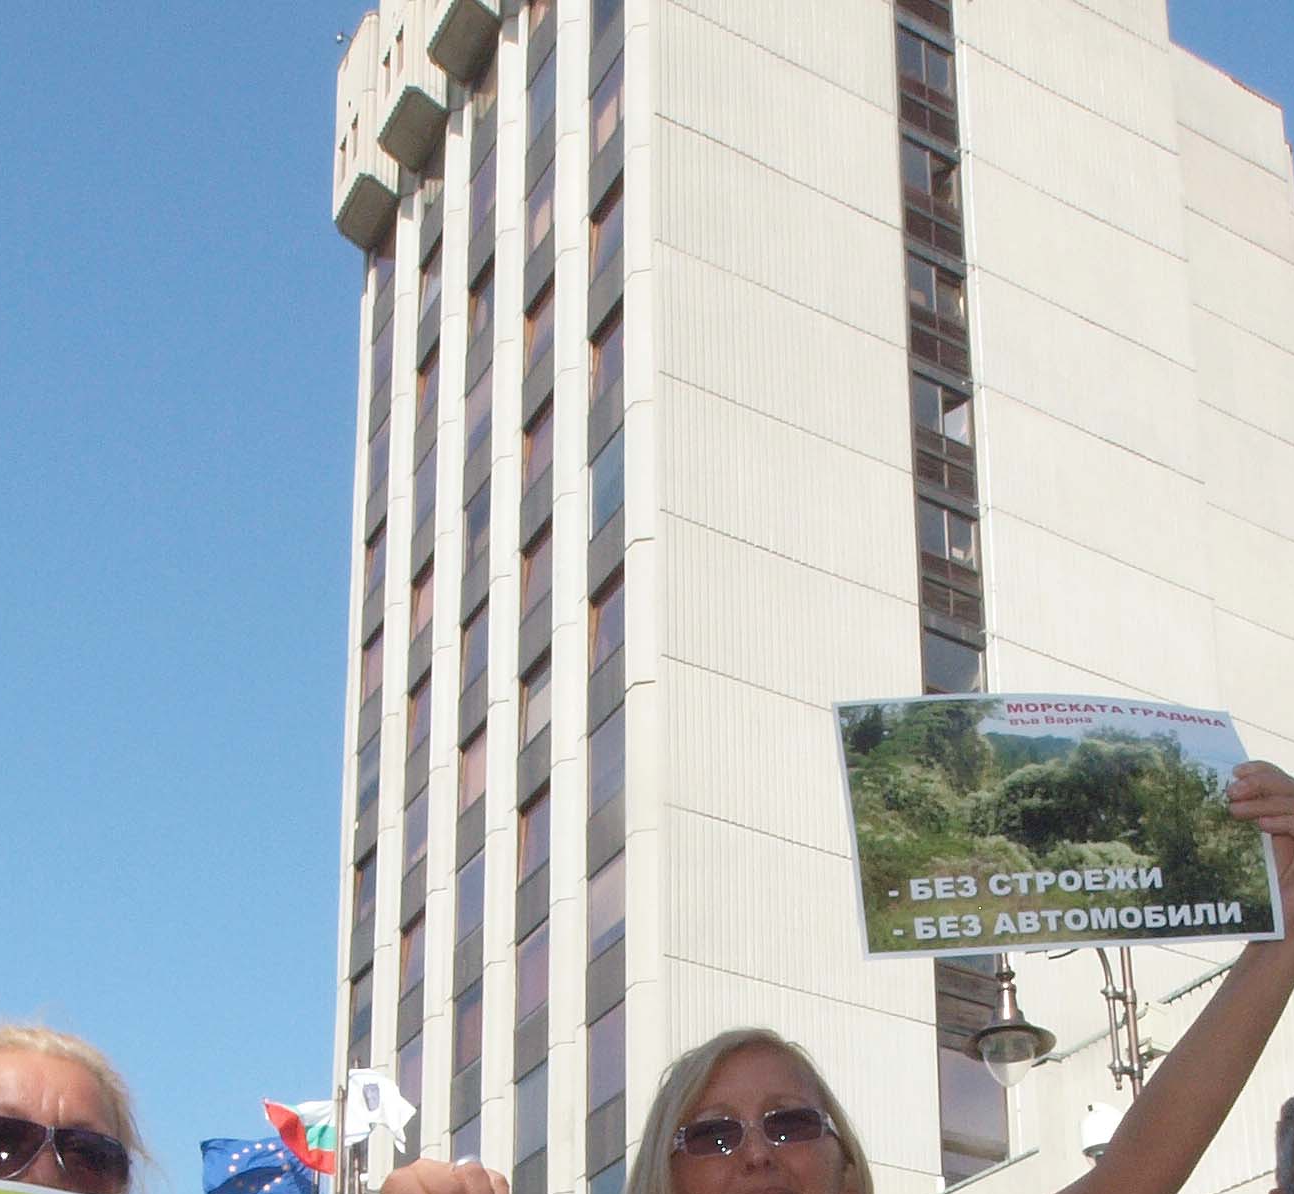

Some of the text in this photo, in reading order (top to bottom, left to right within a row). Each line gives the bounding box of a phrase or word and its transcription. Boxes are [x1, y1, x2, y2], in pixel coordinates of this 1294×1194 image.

[1006, 702, 1226, 728] МОРСКАТА ГРАДИНА
[909, 875, 977, 901] БЕЗ
[988, 867, 1164, 898] СТРОЕЖИ
[913, 913, 983, 940] БЕЗ
[993, 902, 1243, 936] АВТОМОБИЛИ
